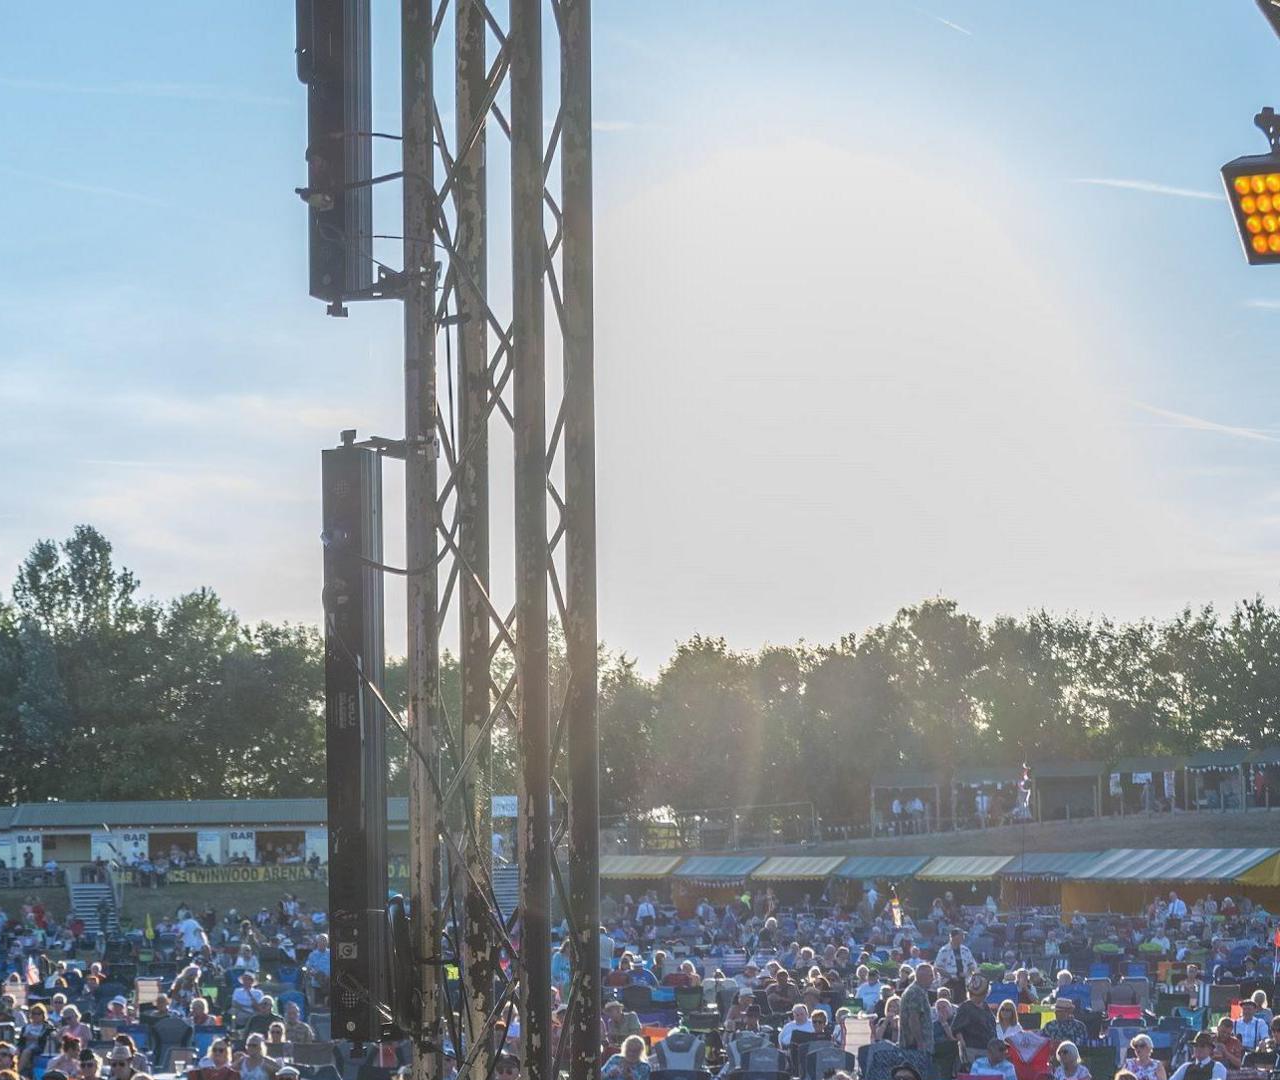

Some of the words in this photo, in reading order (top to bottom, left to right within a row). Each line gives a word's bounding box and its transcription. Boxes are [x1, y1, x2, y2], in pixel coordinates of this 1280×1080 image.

[17, 835, 41, 844] BAR
[123, 833, 147, 842] BAR
[230, 831, 254, 841] BAR
[186, 867, 259, 883] TWINWOOD
[263, 865, 307, 882] ARENA
